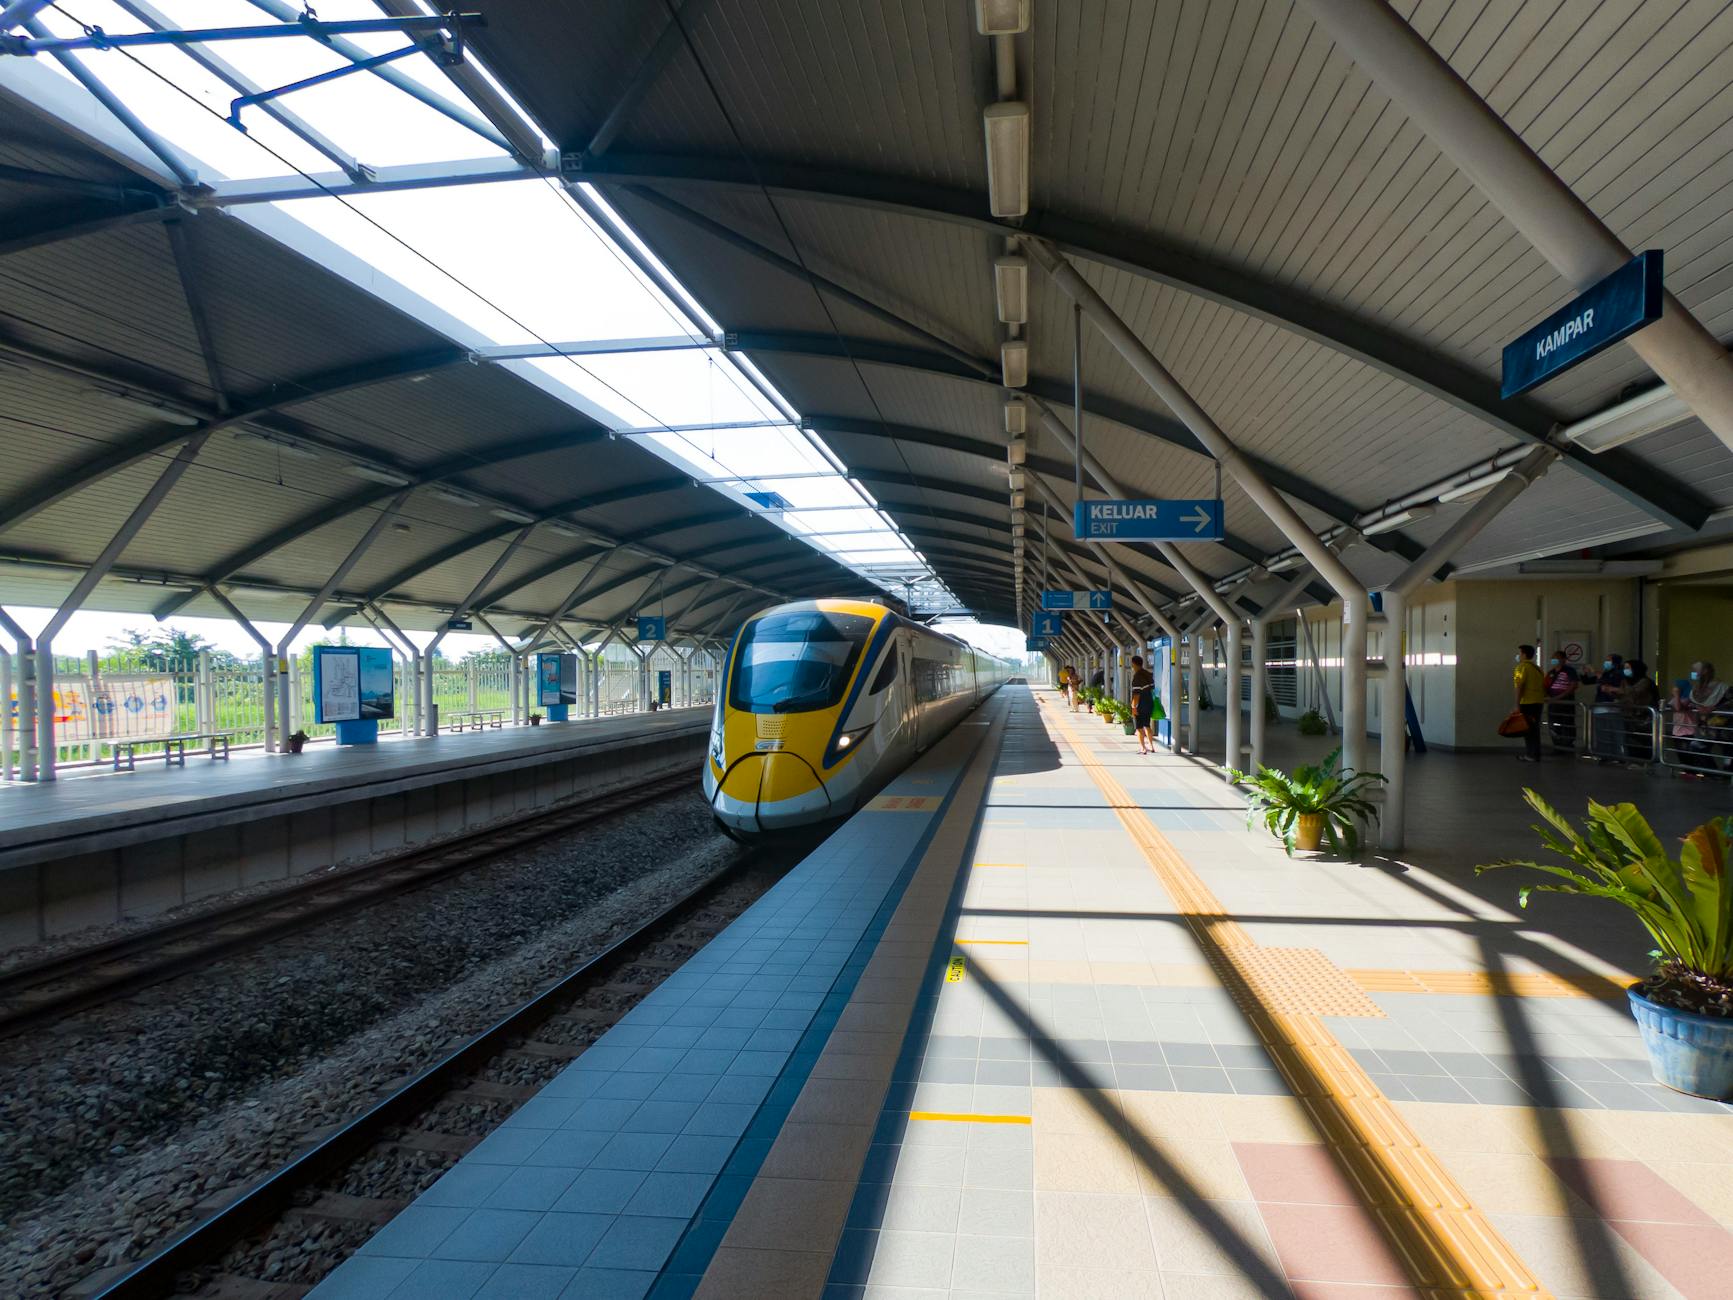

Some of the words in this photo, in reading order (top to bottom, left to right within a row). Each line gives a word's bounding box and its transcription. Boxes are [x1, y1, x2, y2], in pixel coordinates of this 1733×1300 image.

[1536, 308, 1594, 361] KAMPAR
[1090, 504, 1158, 519] KELUAR
[1091, 522, 1119, 534] EXIT
[645, 623, 657, 638] 2
[1042, 618, 1054, 634] 1
[949, 958, 963, 982] CAUTION
